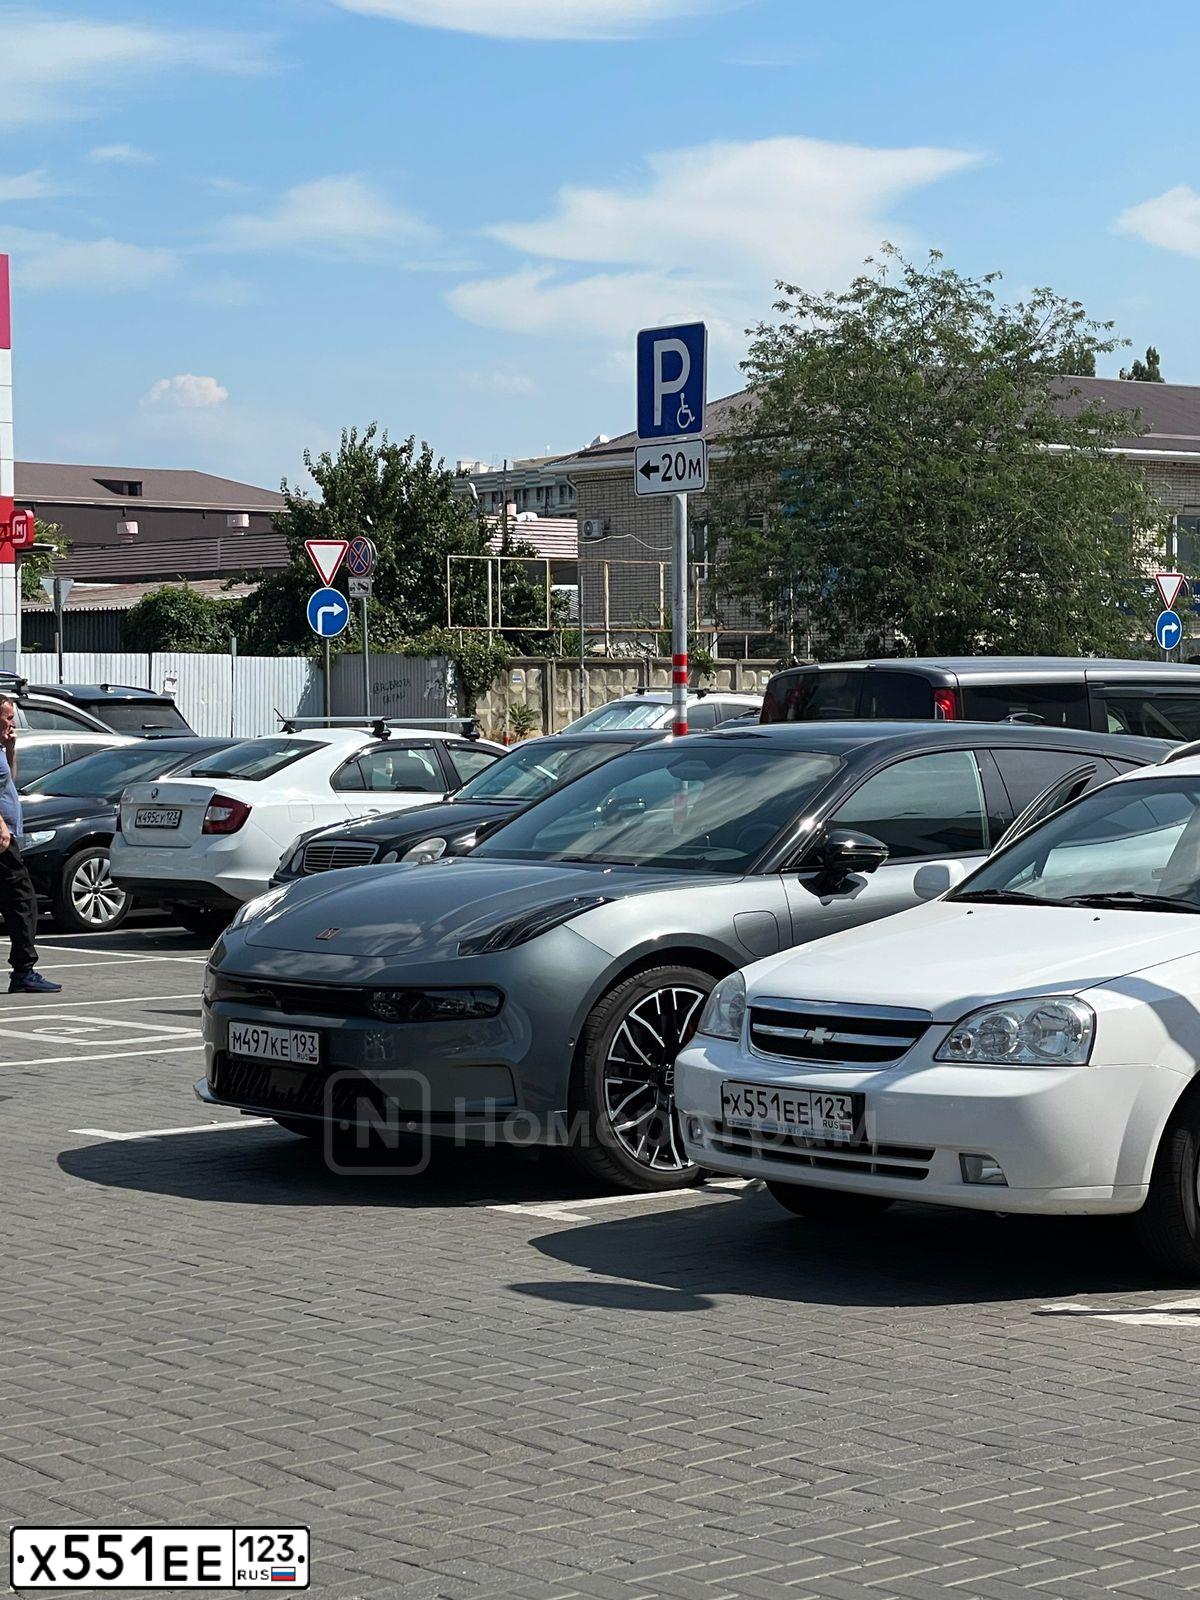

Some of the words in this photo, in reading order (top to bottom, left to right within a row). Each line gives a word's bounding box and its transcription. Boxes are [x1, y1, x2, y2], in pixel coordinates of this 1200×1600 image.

[653, 338, 691, 427] P
[232, 1027, 289, 1057] М497КЕ
[292, 1033, 315, 1054] 193
[730, 1088, 809, 1125] Х551ЕЕ
[814, 1096, 850, 1120] 123
[822, 1119, 839, 1130] RUS
